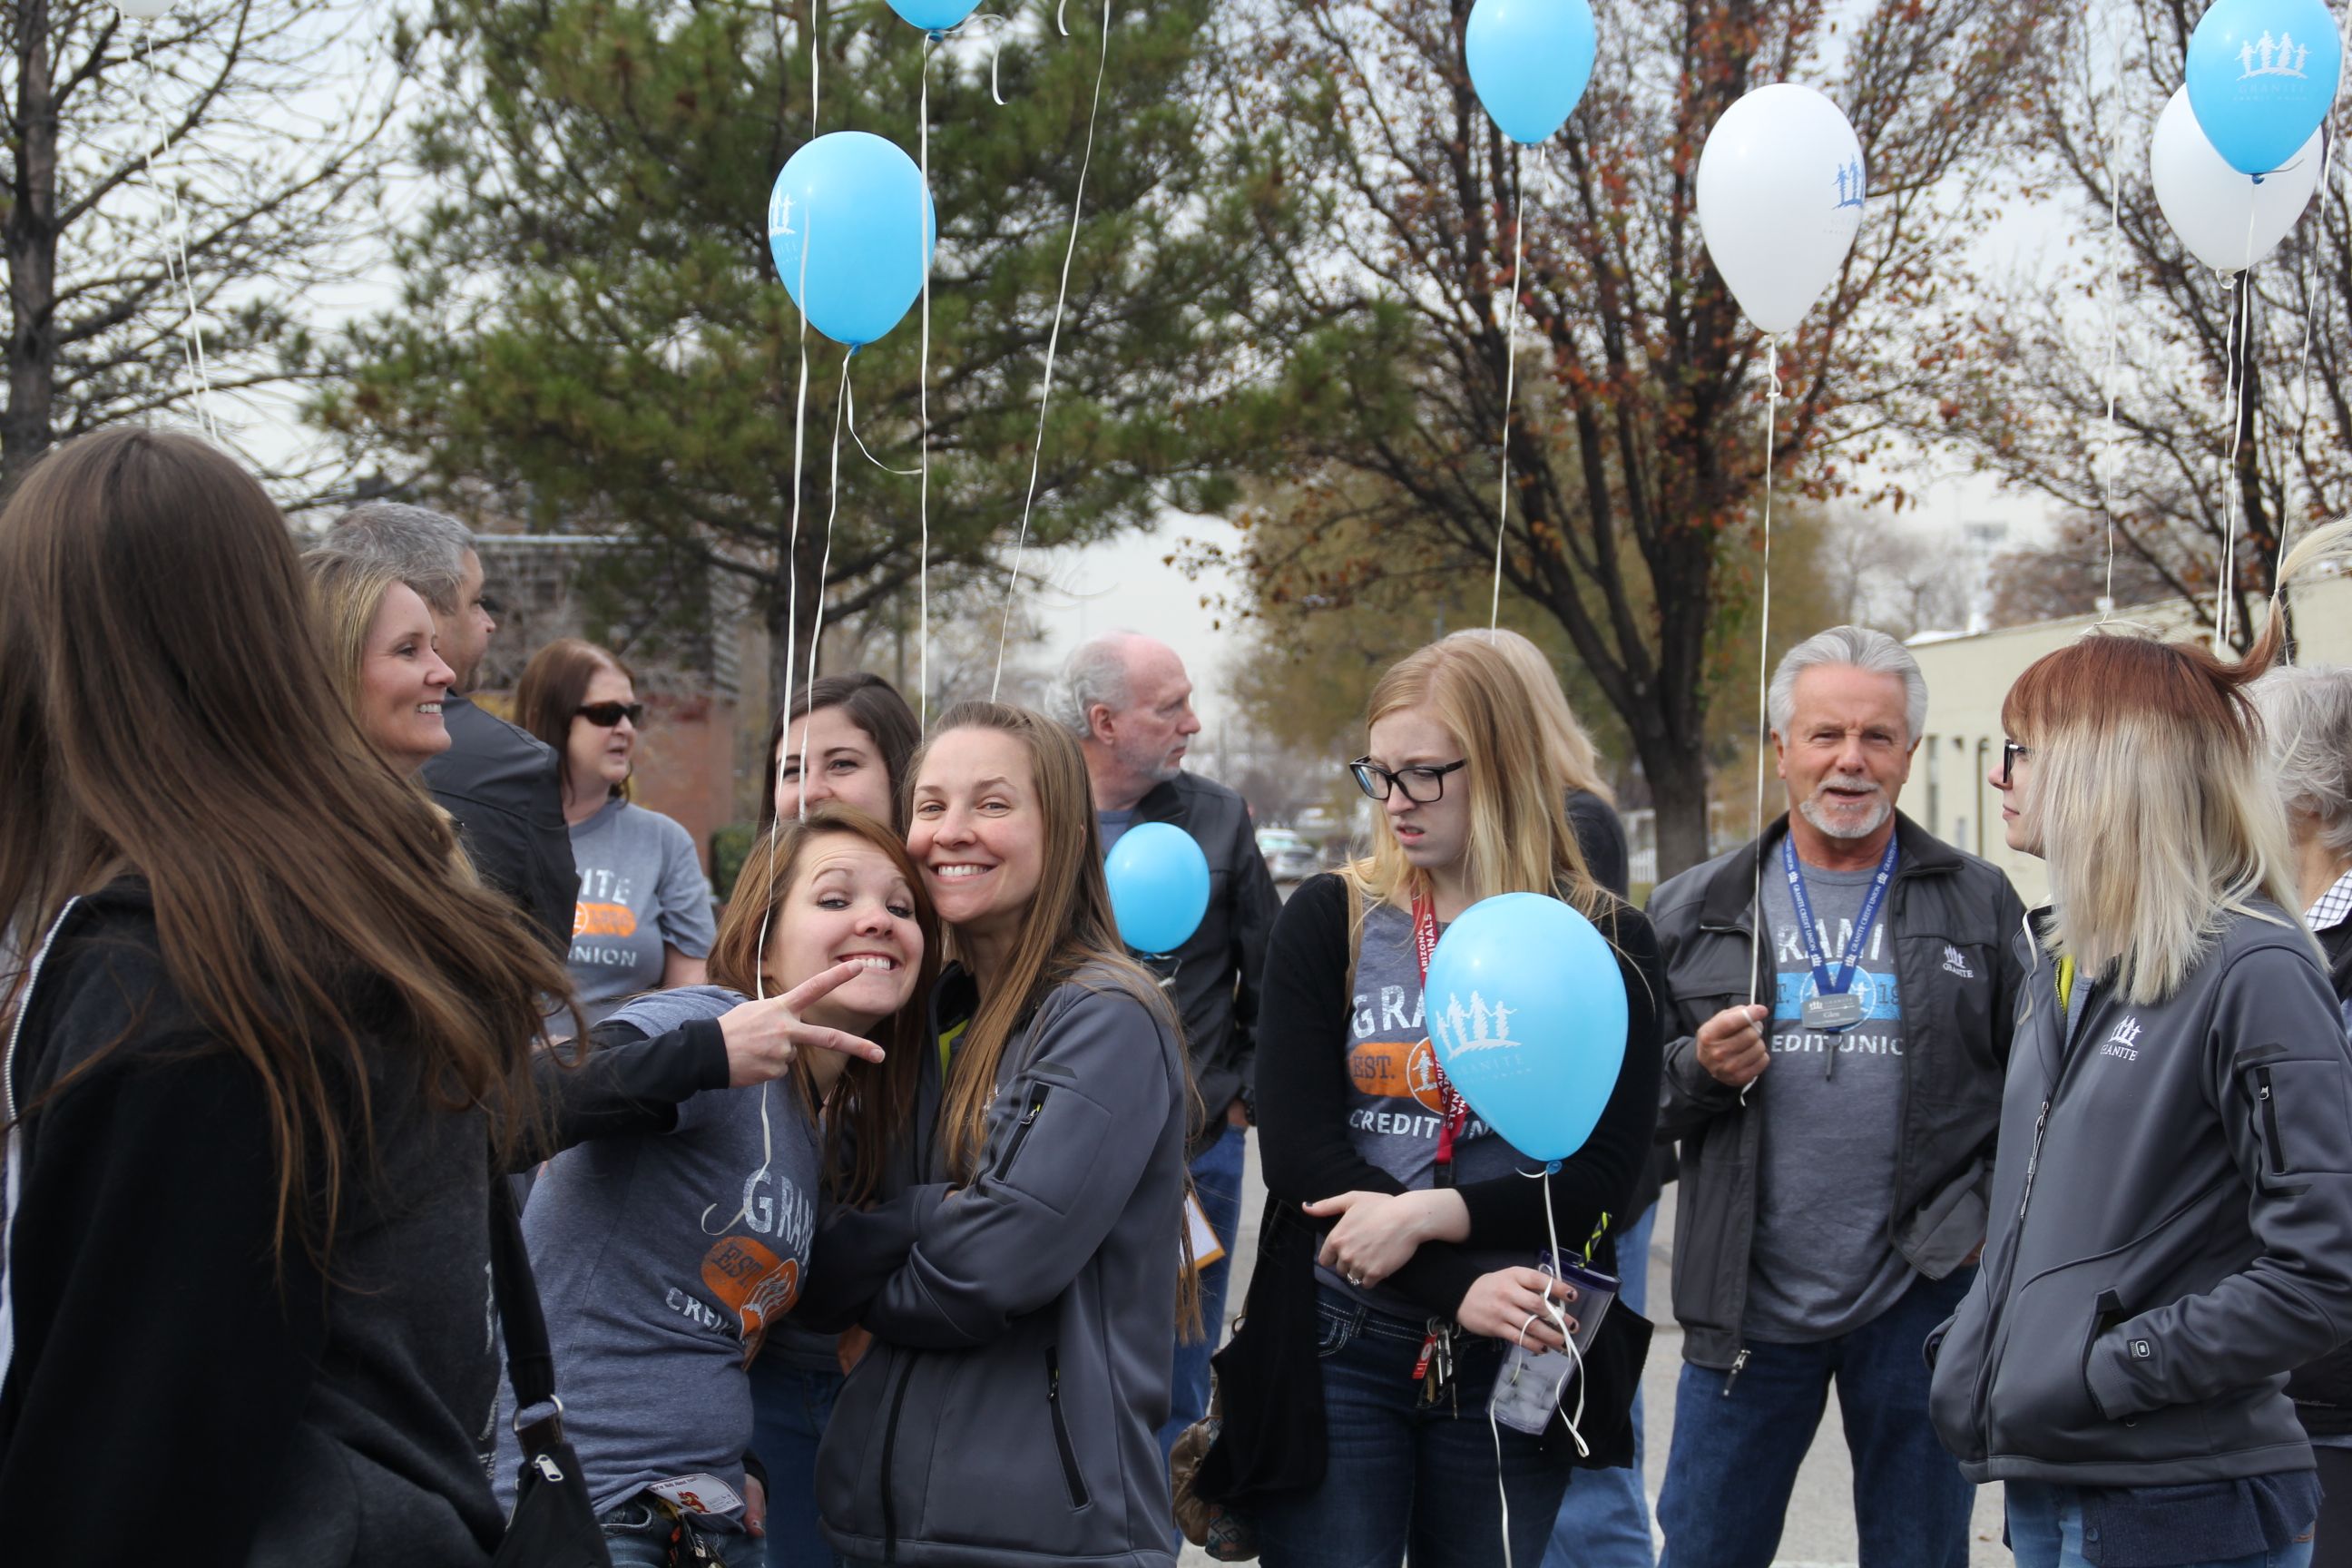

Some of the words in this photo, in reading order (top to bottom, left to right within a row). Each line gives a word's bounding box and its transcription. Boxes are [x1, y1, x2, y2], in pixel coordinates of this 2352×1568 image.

[568, 946, 637, 967] NION
[1417, 928, 1429, 973] ARIZONA
[1352, 1054, 1396, 1080] EST.
[1349, 1108, 1441, 1140] CREDIT
